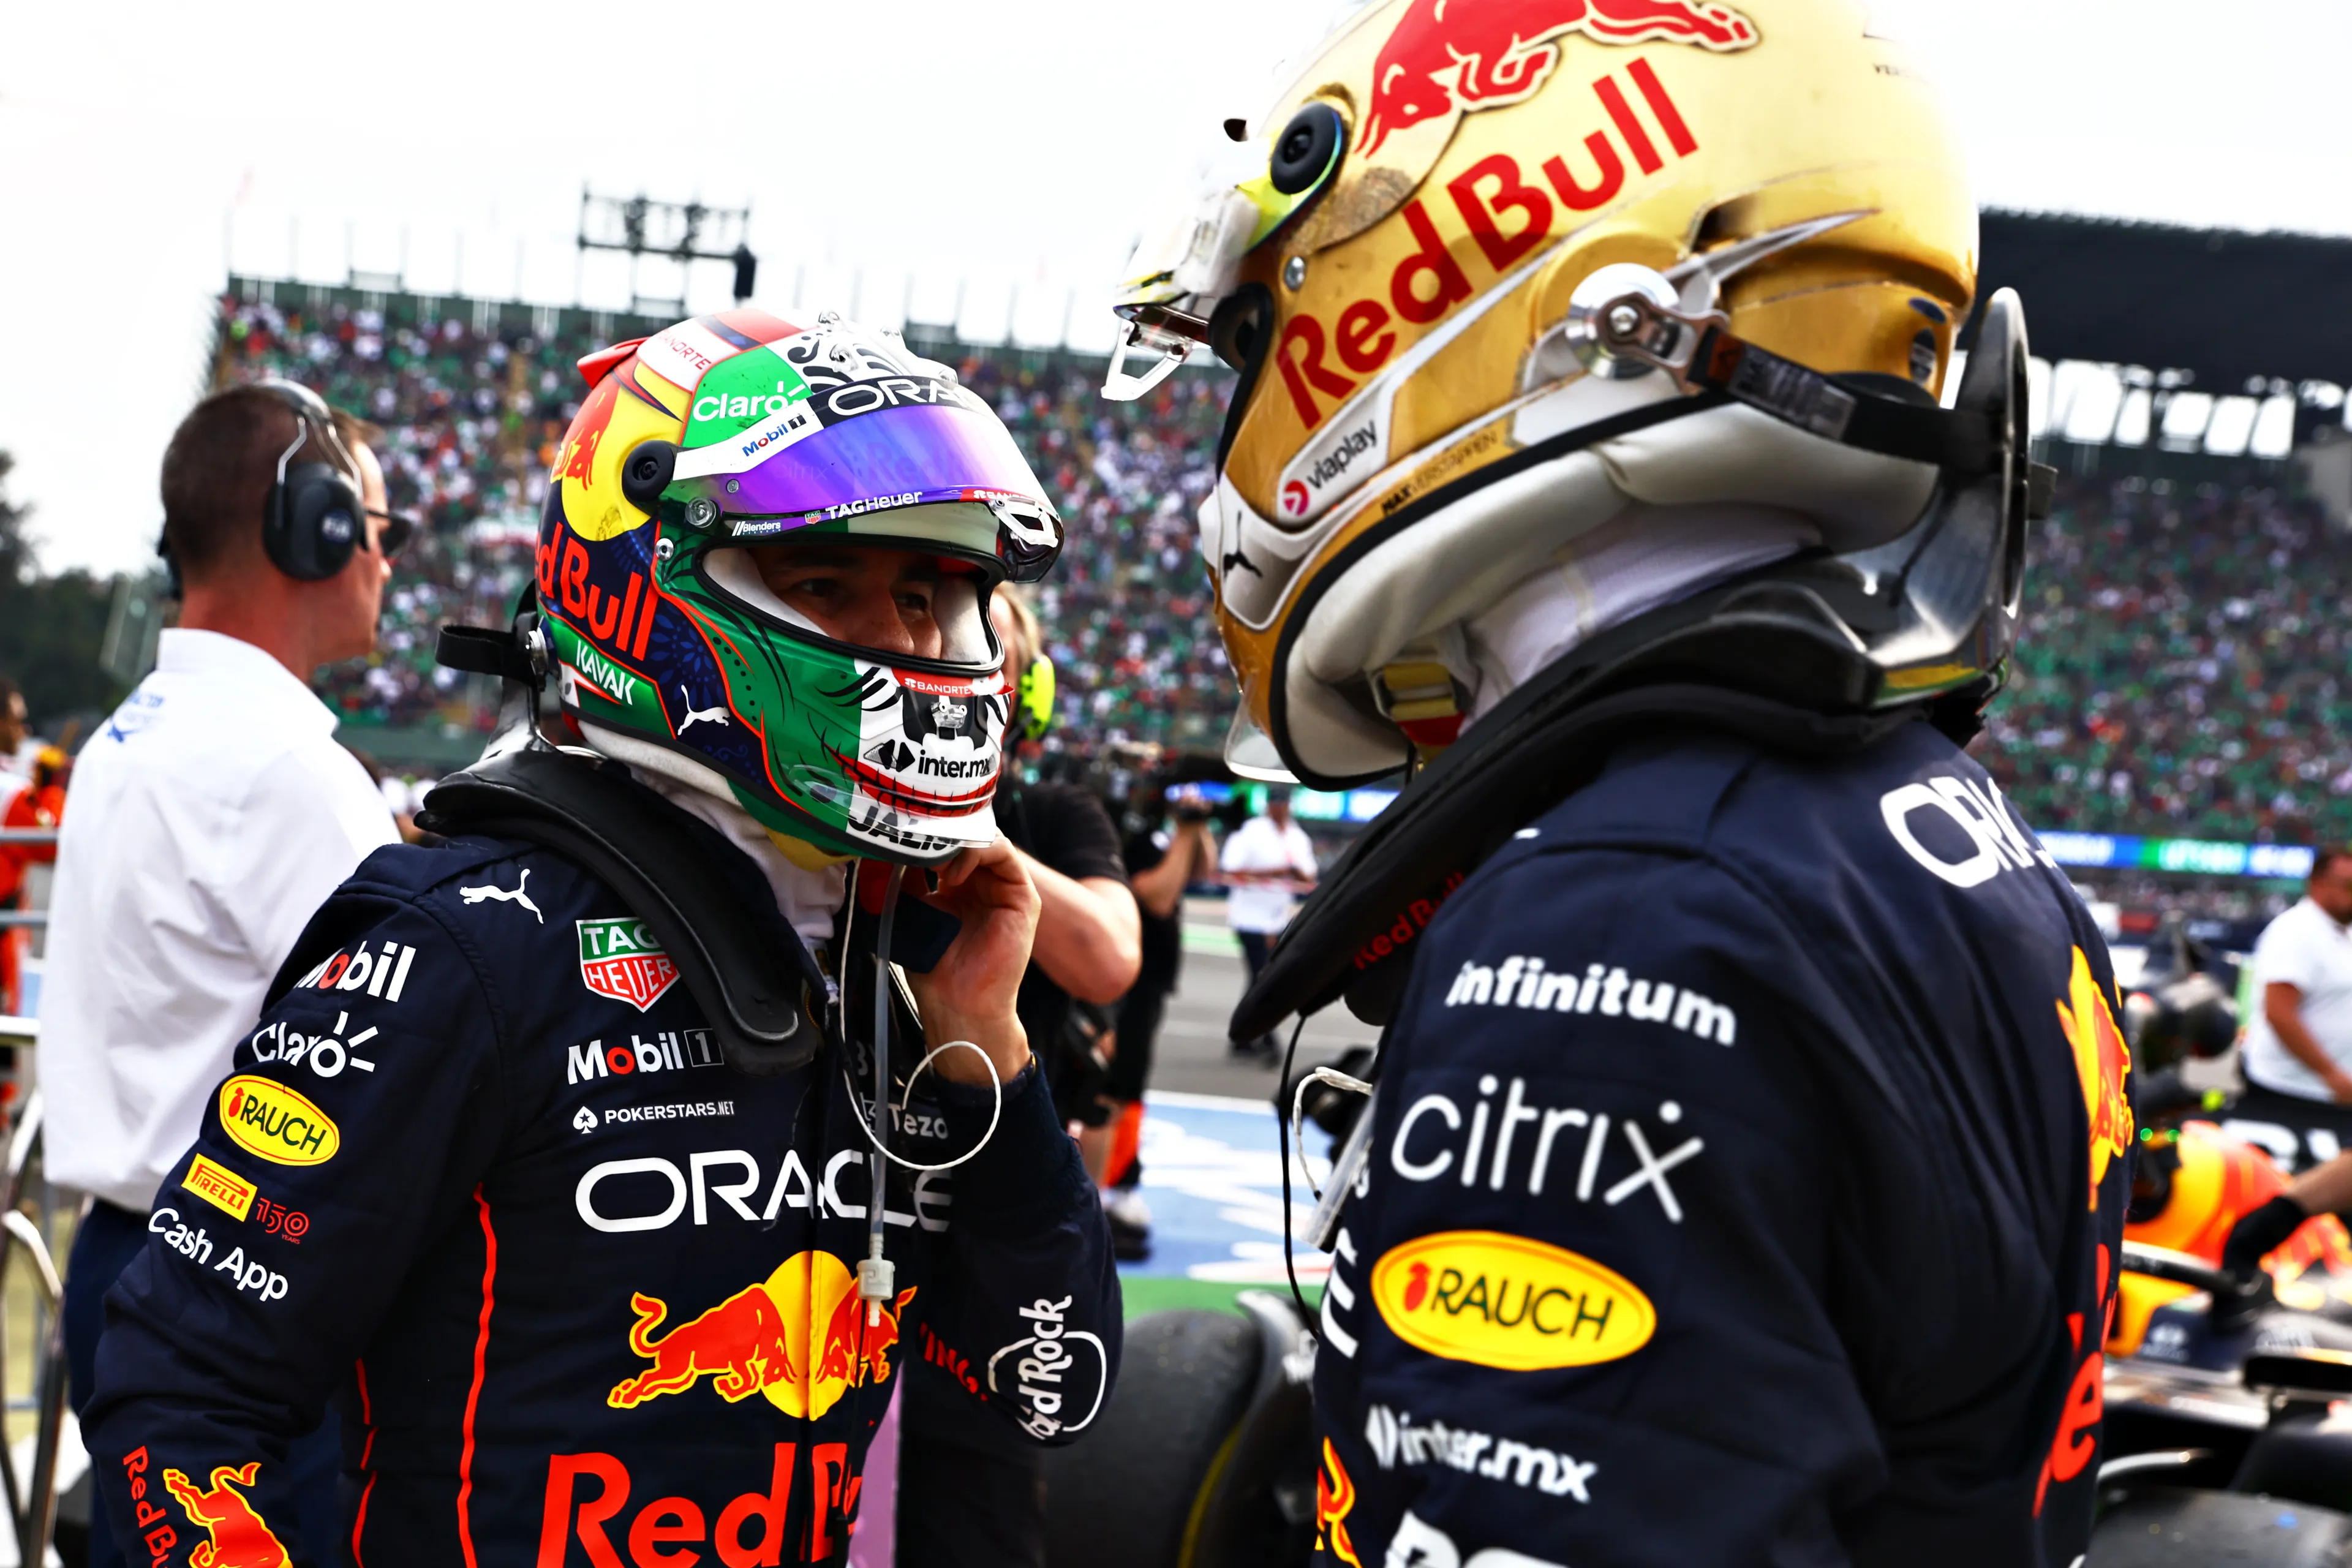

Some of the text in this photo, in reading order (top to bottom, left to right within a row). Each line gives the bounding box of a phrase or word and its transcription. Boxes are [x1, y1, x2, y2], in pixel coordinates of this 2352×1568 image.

[1276, 57, 1698, 431] Red Bull
[693, 393, 788, 421] Claro
[742, 424, 789, 457] Mobil
[1307, 420, 1377, 489] viaplay
[743, 522, 781, 532] Blenders
[560, 537, 658, 662] Bull
[576, 639, 636, 706] KAVAK
[918, 682, 971, 695] BANORTE
[918, 749, 990, 778] inter.mx
[293, 940, 417, 1003] Mobil
[584, 924, 662, 956] TAG
[587, 958, 672, 1003] HEUER
[1446, 956, 1736, 1047] infinitum
[252, 1022, 346, 1078] Claro
[568, 1032, 684, 1085] Mobil
[240, 1094, 327, 1156] RAUCH
[605, 1101, 735, 1124] POKERSTARS.NET
[1391, 1075, 1704, 1223] citrix
[190, 1163, 310, 1237] PIRELLI 150
[148, 1207, 288, 1302] Cash App
[281, 1234, 301, 1245] YEARS
[1431, 1268, 1614, 1341] RAUCH
[1018, 1295, 1072, 1382] Rock
[123, 1446, 167, 1528] Red
[537, 1442, 796, 1568] Red
